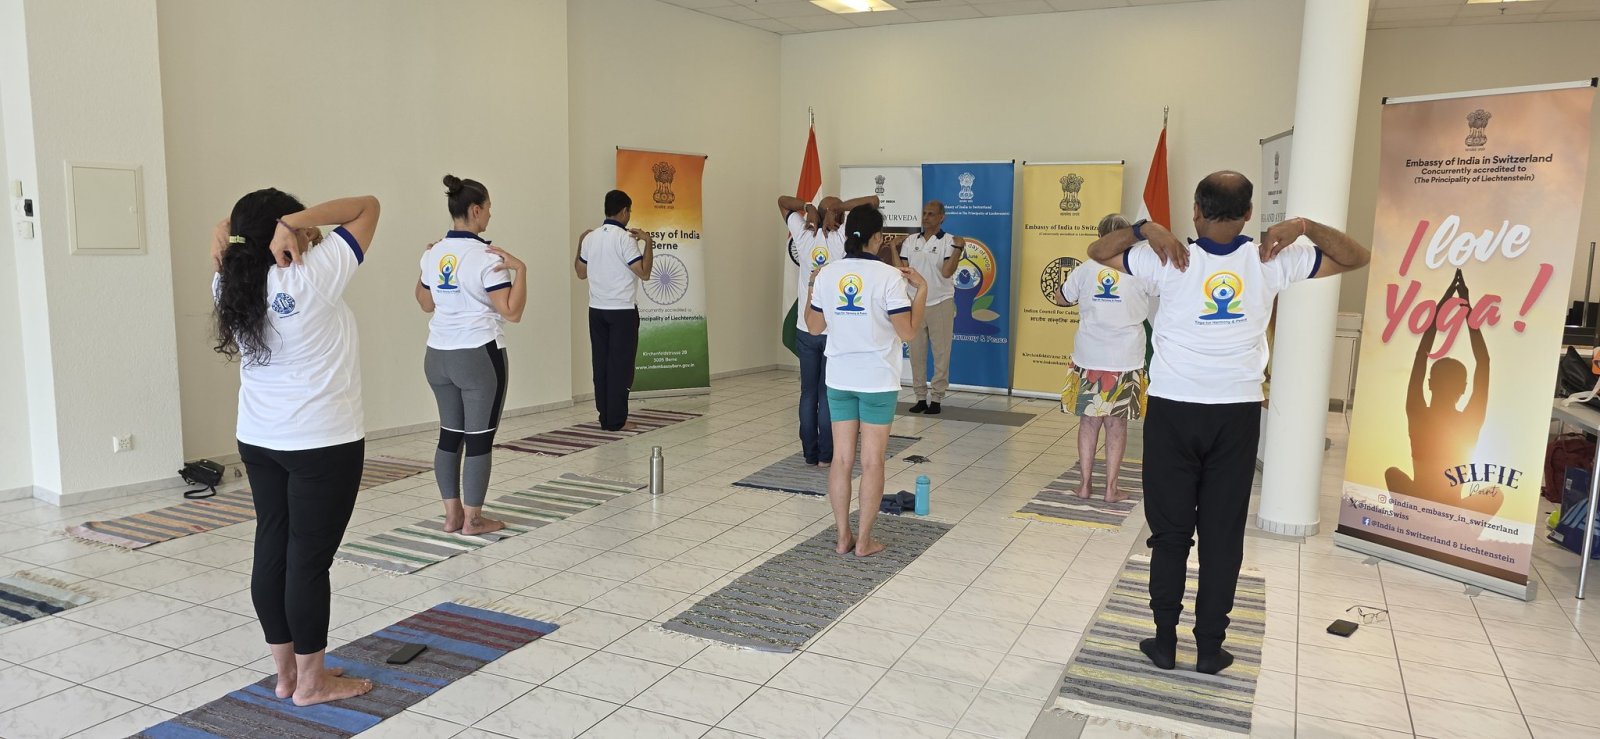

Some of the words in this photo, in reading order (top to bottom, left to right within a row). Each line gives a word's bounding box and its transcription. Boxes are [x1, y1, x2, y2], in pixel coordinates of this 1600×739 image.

[1405, 159, 1443, 168] Embassy
[1445, 157, 1456, 166] of
[1457, 157, 1480, 166] India
[1482, 156, 1491, 165] in
[1492, 153, 1553, 165] Switzerland
[1421, 167, 1472, 176] Concurrently
[1473, 165, 1515, 174] accredited
[1414, 177, 1429, 185] (The
[1430, 175, 1471, 185] Principality
[1472, 174, 1480, 183] of
[1481, 173, 1535, 183] Liechtenstein)
[883, 214, 918, 222] YURVEDA
[667, 229, 678, 239] of
[680, 230, 700, 240] India
[1024, 223, 1049, 231] Embassy
[1057, 223, 1073, 231] India
[651, 241, 678, 250] Berne
[1399, 219, 1430, 277] I
[1425, 214, 1531, 270] love
[1444, 463, 1523, 489] SELFIE
[1469, 483, 1500, 498] Point
[1357, 502, 1409, 521] @IndiainSwiss
[1388, 498, 1519, 536] @indian_embassy_in_switzerland
[1371, 519, 1395, 532] @India
[1396, 523, 1405, 533] in
[1405, 529, 1451, 546] Switzerland
[1452, 541, 1458, 549] &
[1459, 543, 1515, 564] Liechtenstein
